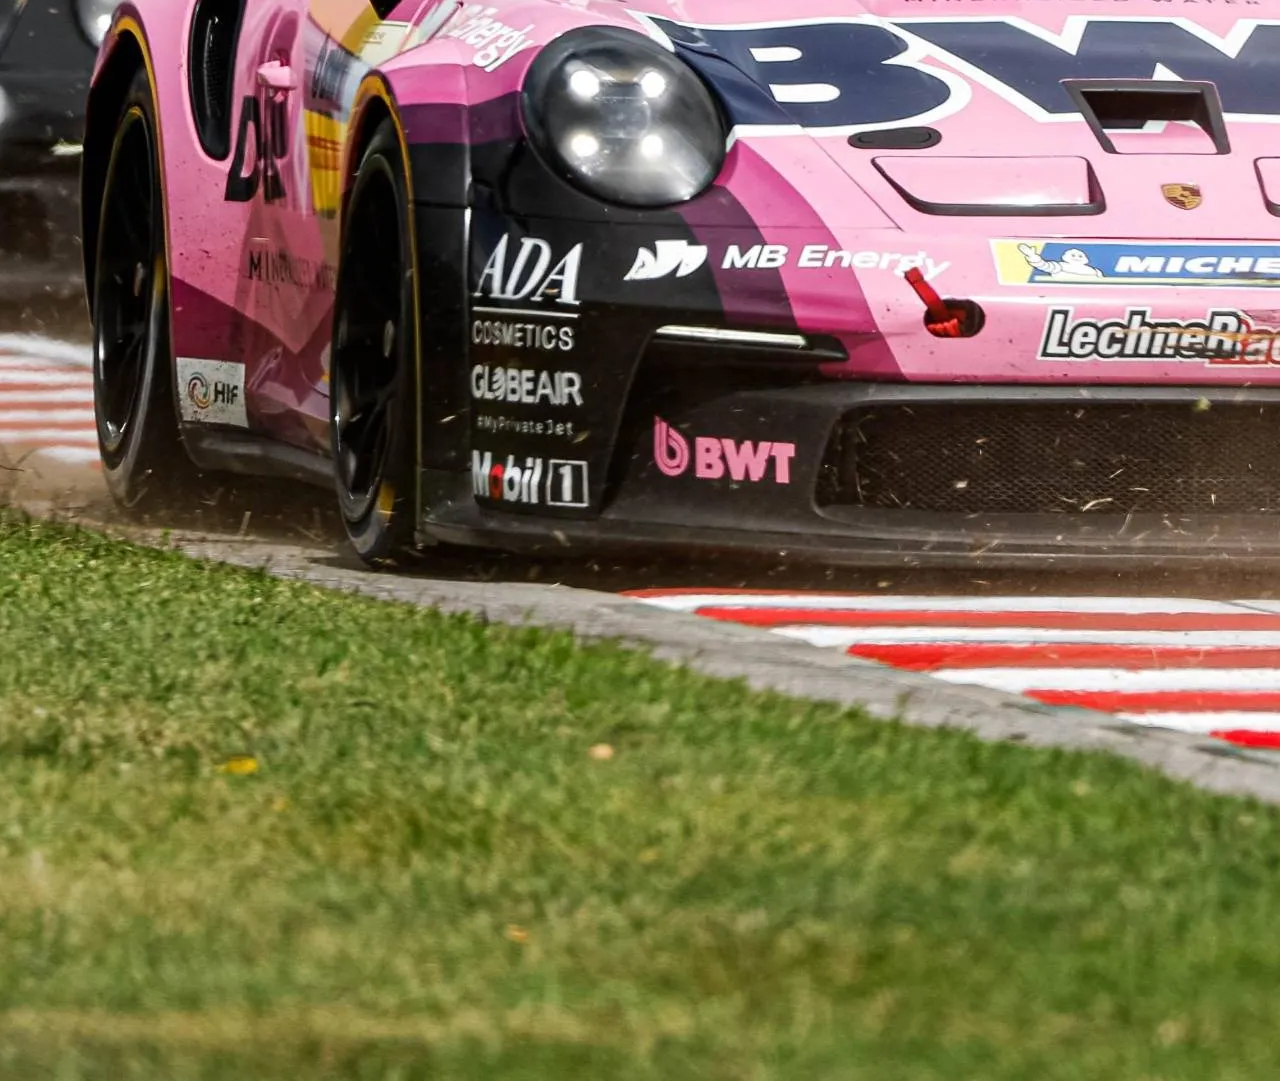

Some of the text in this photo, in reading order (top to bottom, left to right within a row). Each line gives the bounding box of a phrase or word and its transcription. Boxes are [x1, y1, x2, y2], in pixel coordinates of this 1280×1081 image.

[472, 232, 584, 306] ADA
[721, 244, 952, 281] MB Energy
[472, 319, 576, 351] COSMETICS
[214, 382, 239, 405] HIF
[471, 363, 585, 407] GLOBEAIR
[472, 449, 544, 505] Mobil
[694, 435, 797, 485] BWT
